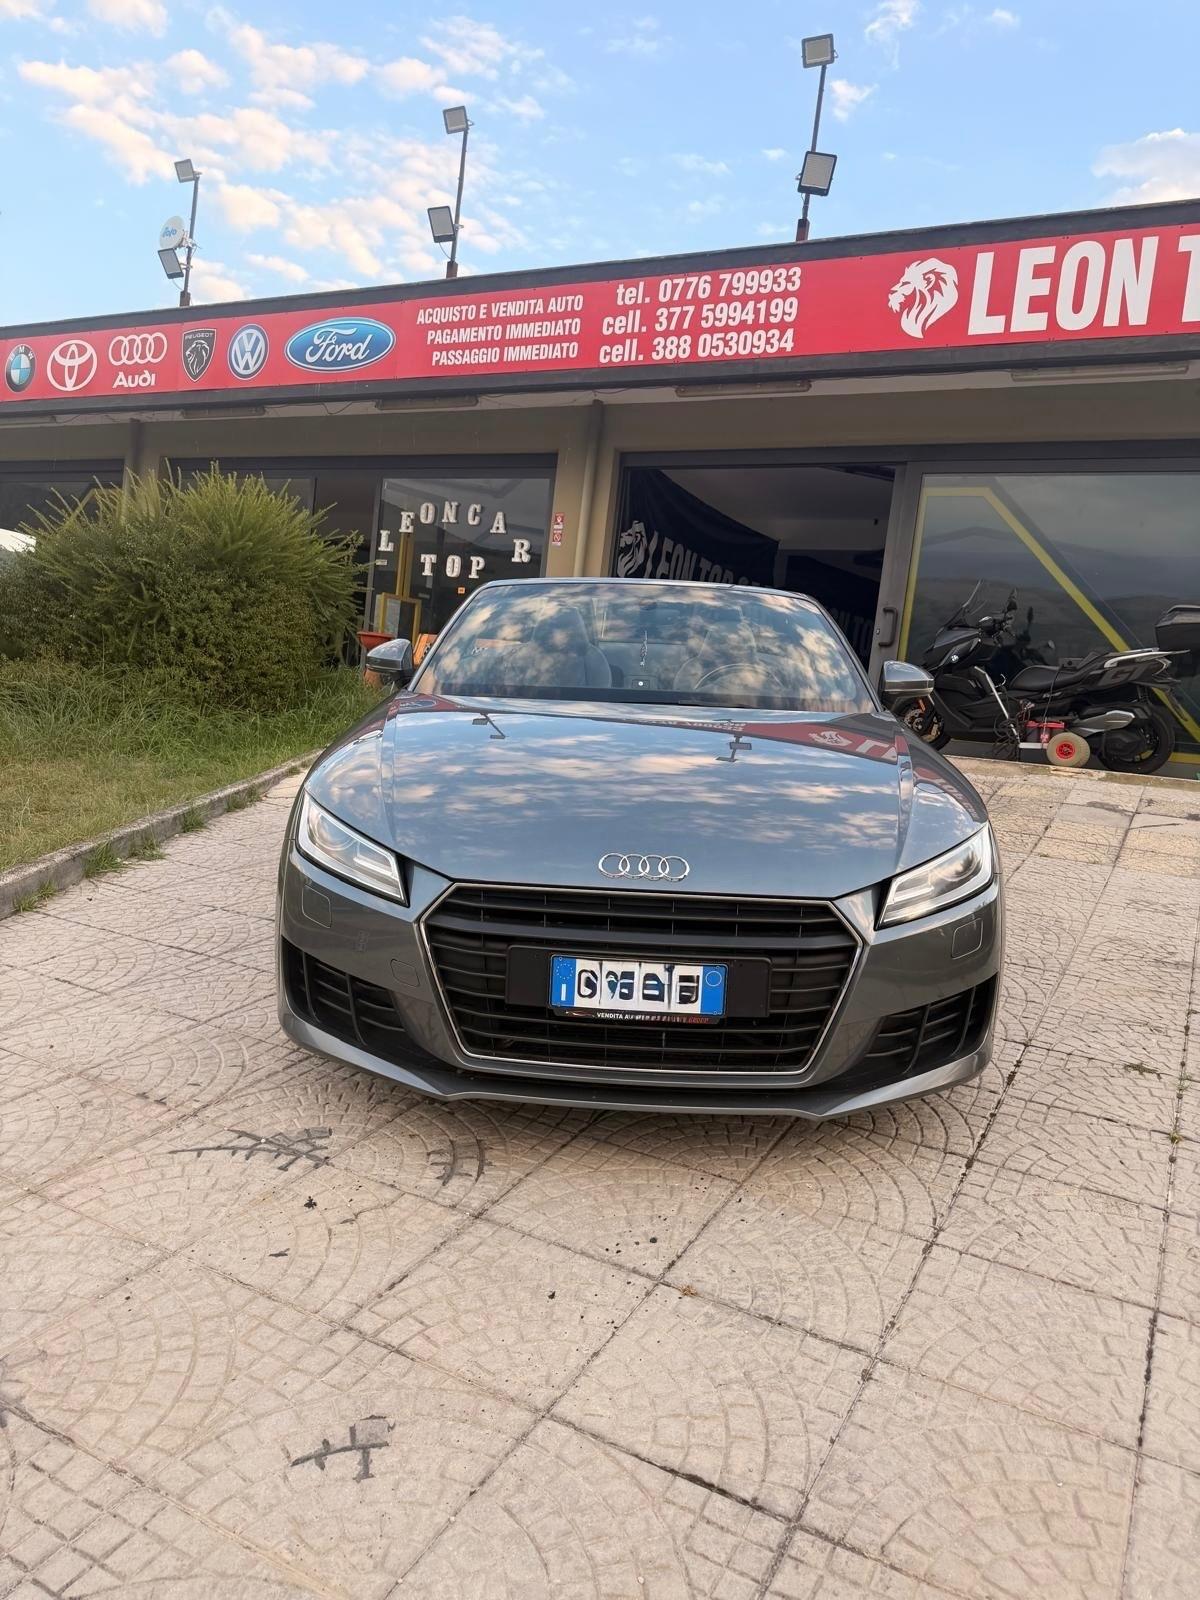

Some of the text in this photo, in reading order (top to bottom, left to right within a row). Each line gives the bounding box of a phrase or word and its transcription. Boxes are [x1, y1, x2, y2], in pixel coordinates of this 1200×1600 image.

[616, 267, 802, 306] tel. 0776 799933
[967, 236, 1160, 336] LEON
[416, 294, 584, 325] ACQUISTO E VENDITA AUTO
[602, 296, 799, 336] cell. 377 5994199
[185, 332, 214, 340] PEUGEOT
[305, 327, 373, 363] Ford
[426, 318, 581, 345] PAGAMENTO IMMEDIATO
[599, 328, 794, 364] cell. 388 0530934
[431, 341, 579, 366] PASSAGGIO IMMEDIATO
[112, 369, 156, 389] Audi
[420, 554, 485, 579] TOP
[596, 1012, 623, 1020] VENDITA
